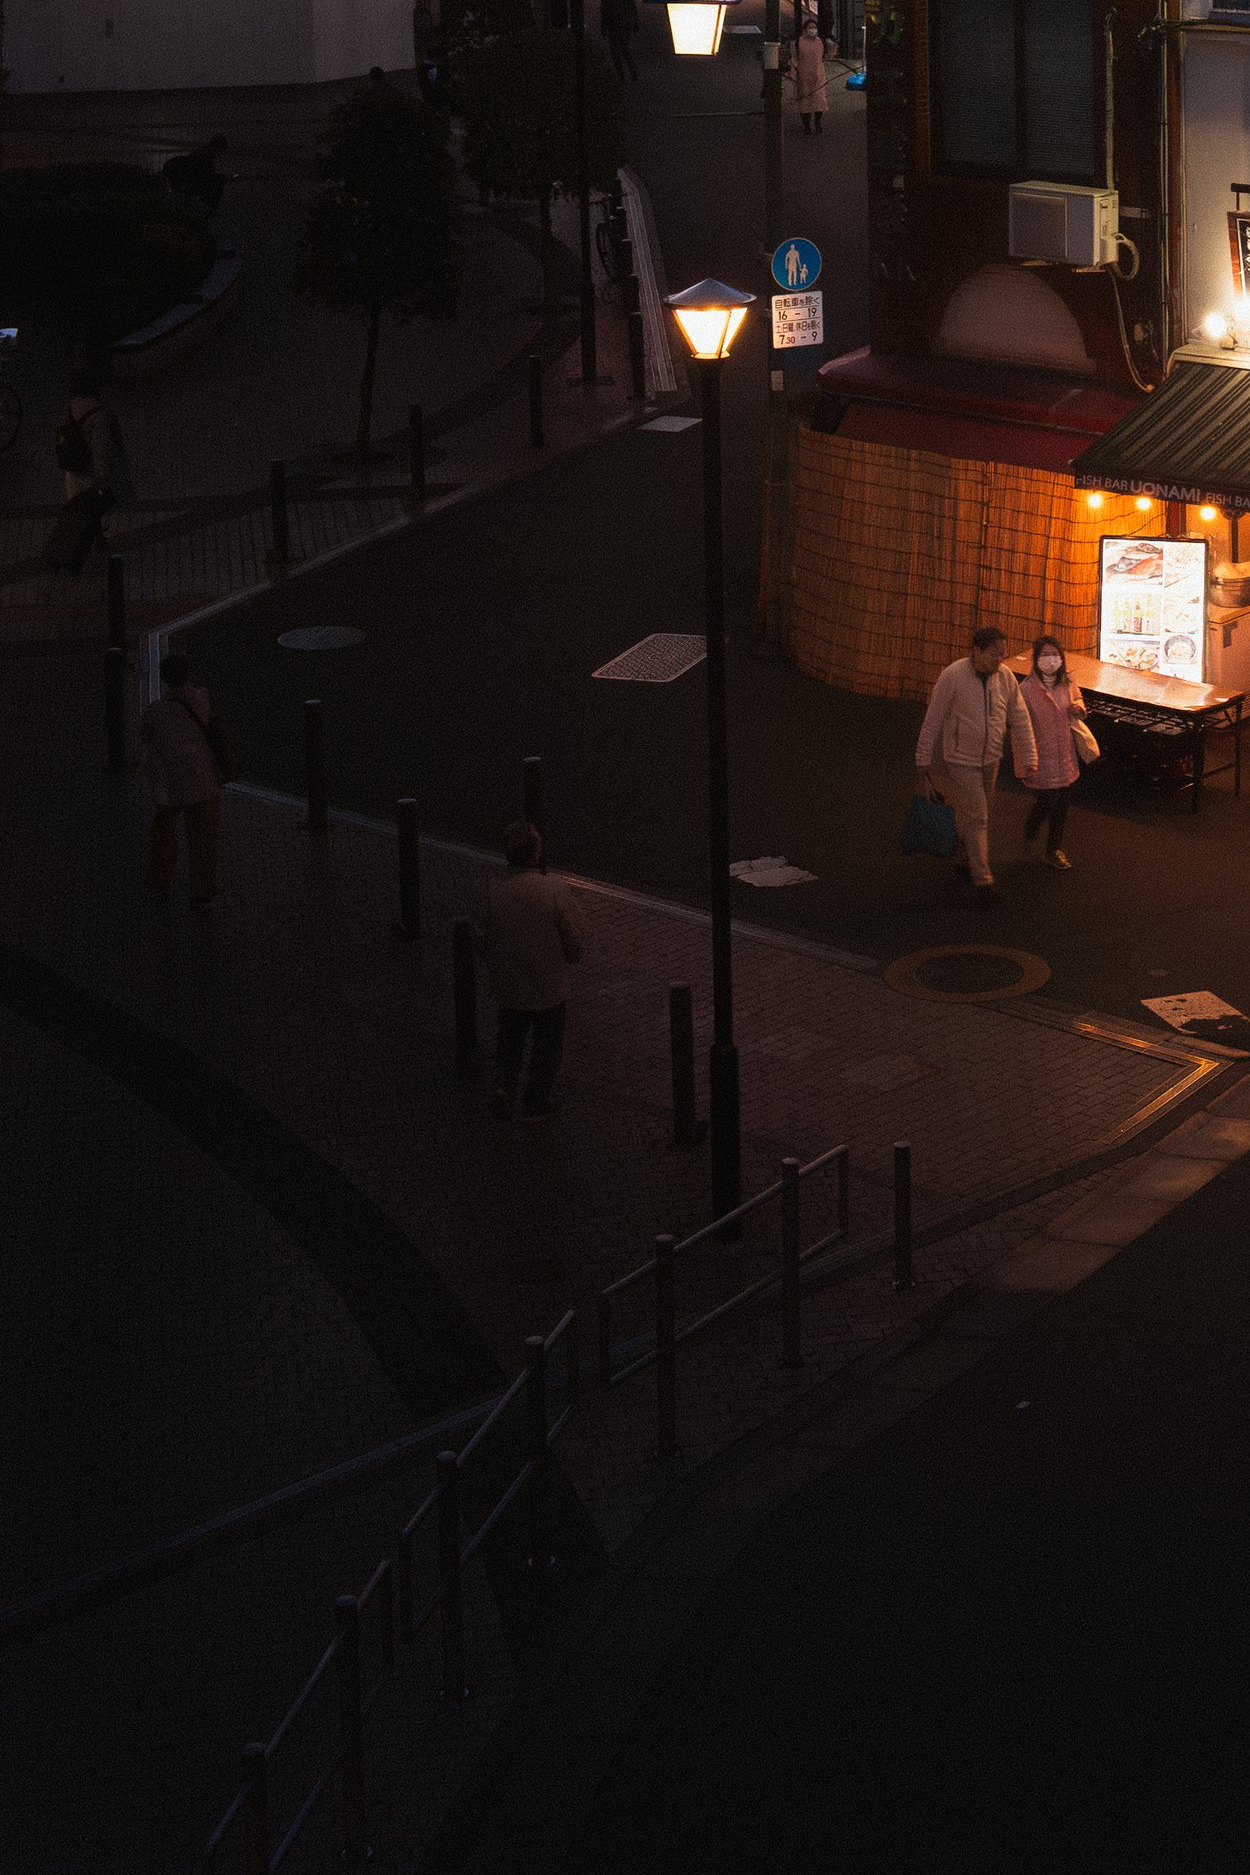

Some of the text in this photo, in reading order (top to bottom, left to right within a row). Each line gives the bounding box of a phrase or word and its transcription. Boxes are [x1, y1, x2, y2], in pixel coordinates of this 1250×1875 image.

[775, 296, 820, 309] 自転車を除く
[778, 311, 788, 321] 16
[807, 308, 817, 318] 19
[1104, 478, 1128, 491] BAR
[1130, 480, 1202, 502] UONAMI
[1206, 492, 1232, 505] FISH
